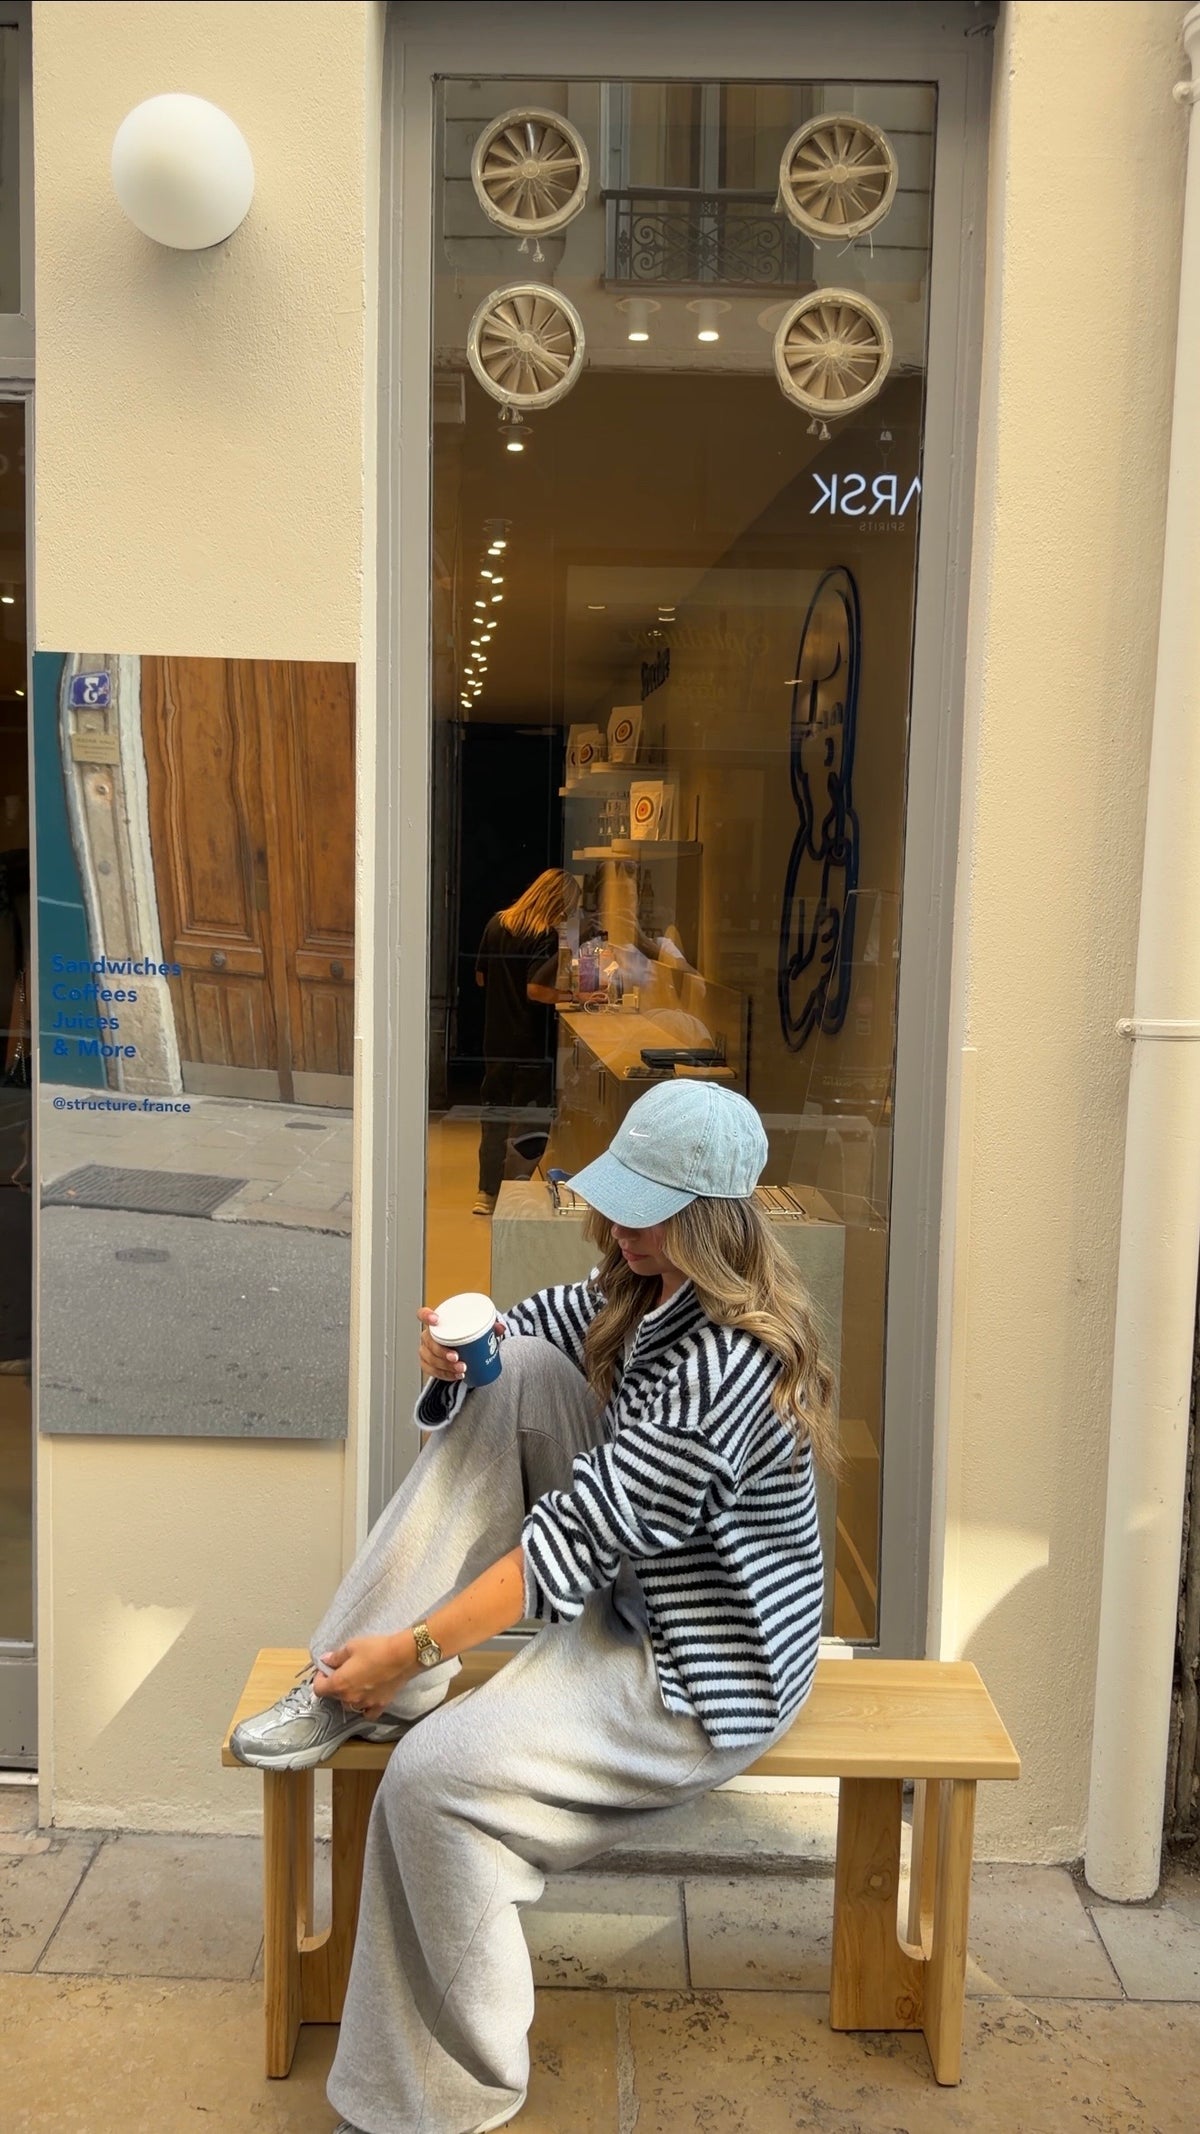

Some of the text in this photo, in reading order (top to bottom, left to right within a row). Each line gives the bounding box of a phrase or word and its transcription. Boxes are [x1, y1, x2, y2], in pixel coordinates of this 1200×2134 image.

[52, 954, 182, 976] Sandwiches
[52, 982, 138, 1003] Coffees
[52, 1012, 120, 1031] Juices
[53, 1038, 137, 1058] & More
[53, 1097, 191, 1113] @structure.france
